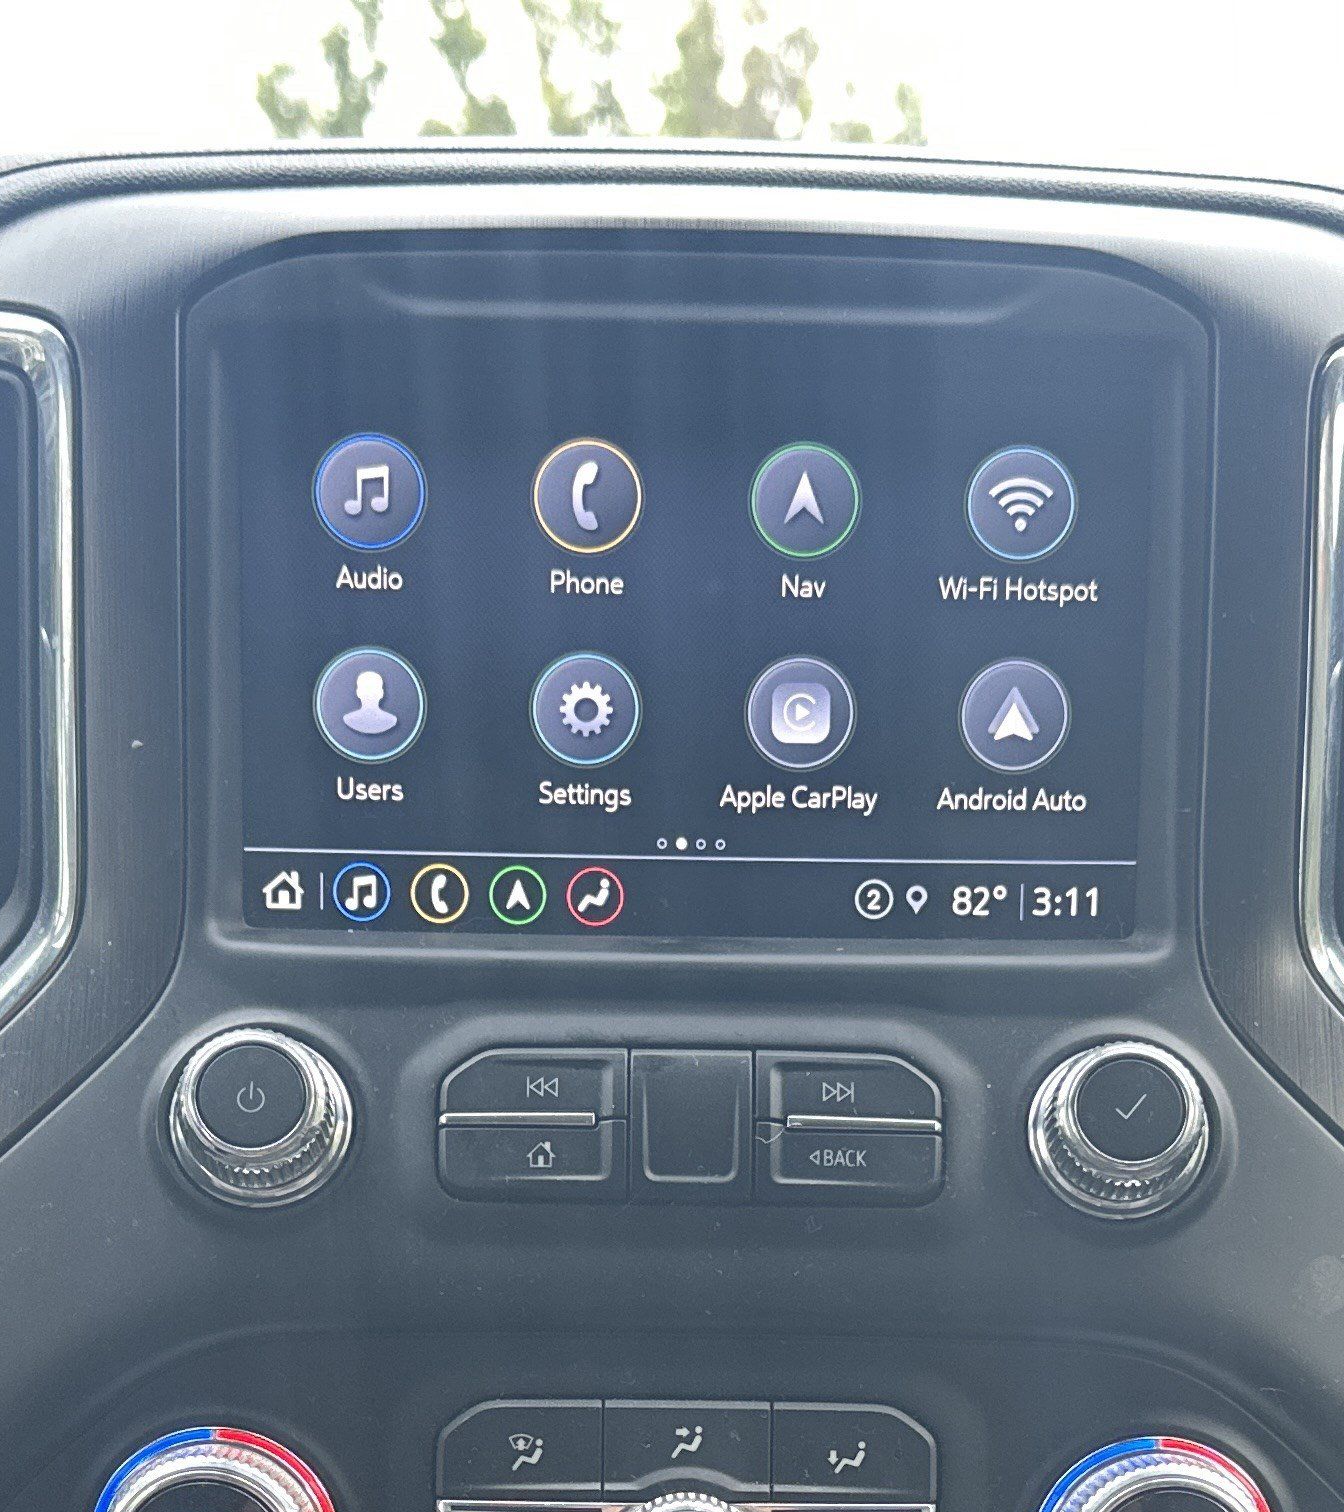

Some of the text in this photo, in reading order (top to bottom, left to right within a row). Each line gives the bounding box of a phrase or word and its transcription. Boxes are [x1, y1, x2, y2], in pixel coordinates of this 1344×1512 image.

[334, 566, 404, 592] Audio
[549, 570, 625, 595] Phone
[780, 574, 827, 600] Nav
[937, 576, 1099, 606] Wi-Fi Hotspot
[335, 776, 405, 803] Users
[538, 781, 632, 812] Settings
[718, 783, 879, 816] Apple CarPlay
[935, 787, 1088, 814] Android Auto
[951, 885, 1009, 915] 82°
[1031, 887, 1100, 917] 3:11
[823, 1148, 868, 1168] BACK
